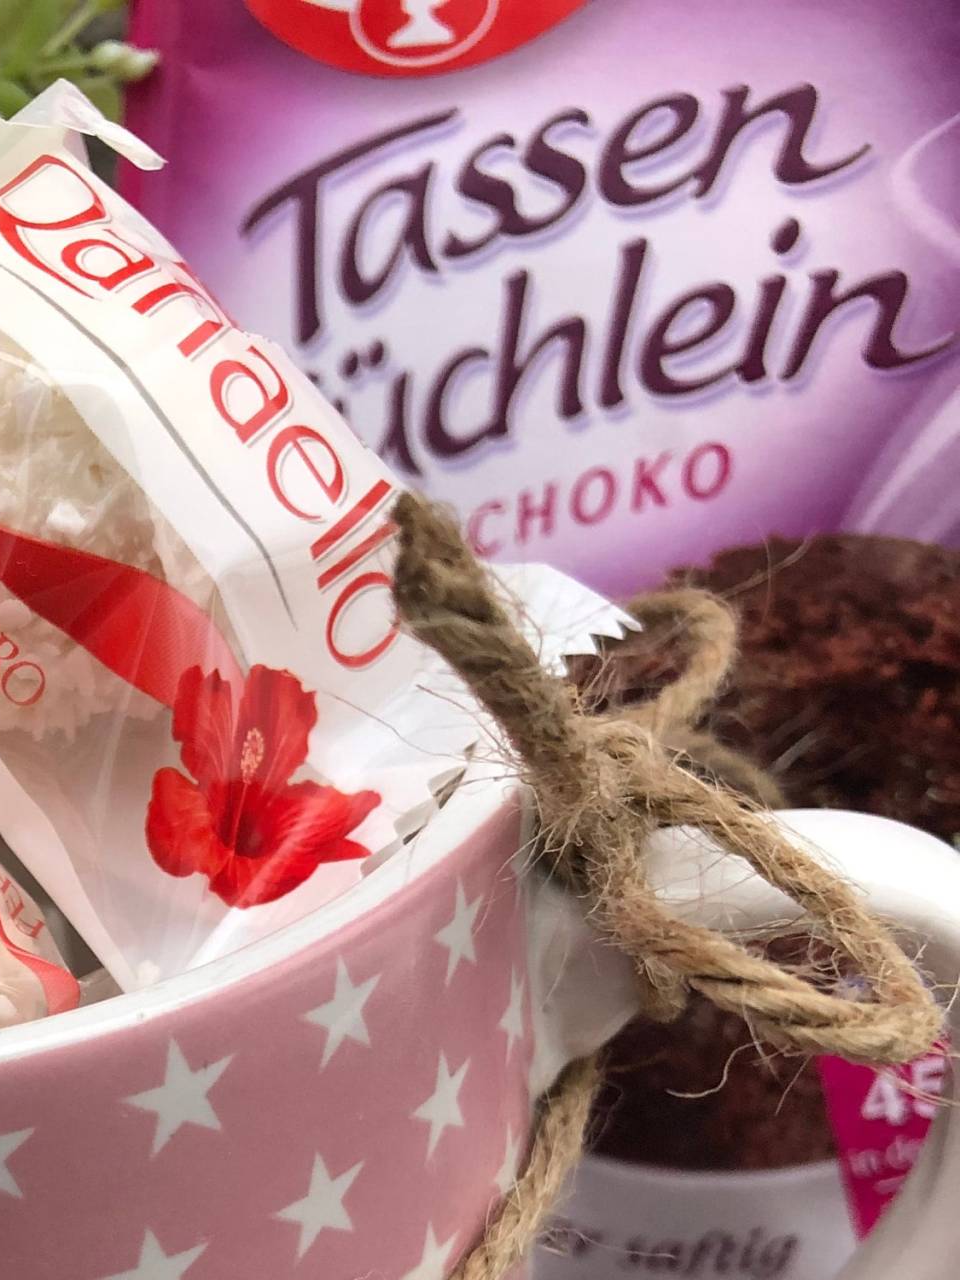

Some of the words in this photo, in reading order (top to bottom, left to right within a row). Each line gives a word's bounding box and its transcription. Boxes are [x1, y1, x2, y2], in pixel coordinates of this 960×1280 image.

[240, 82, 872, 345] Tassen
[306, 217, 956, 478] üchlein
[467, 440, 732, 558] CHOKO
